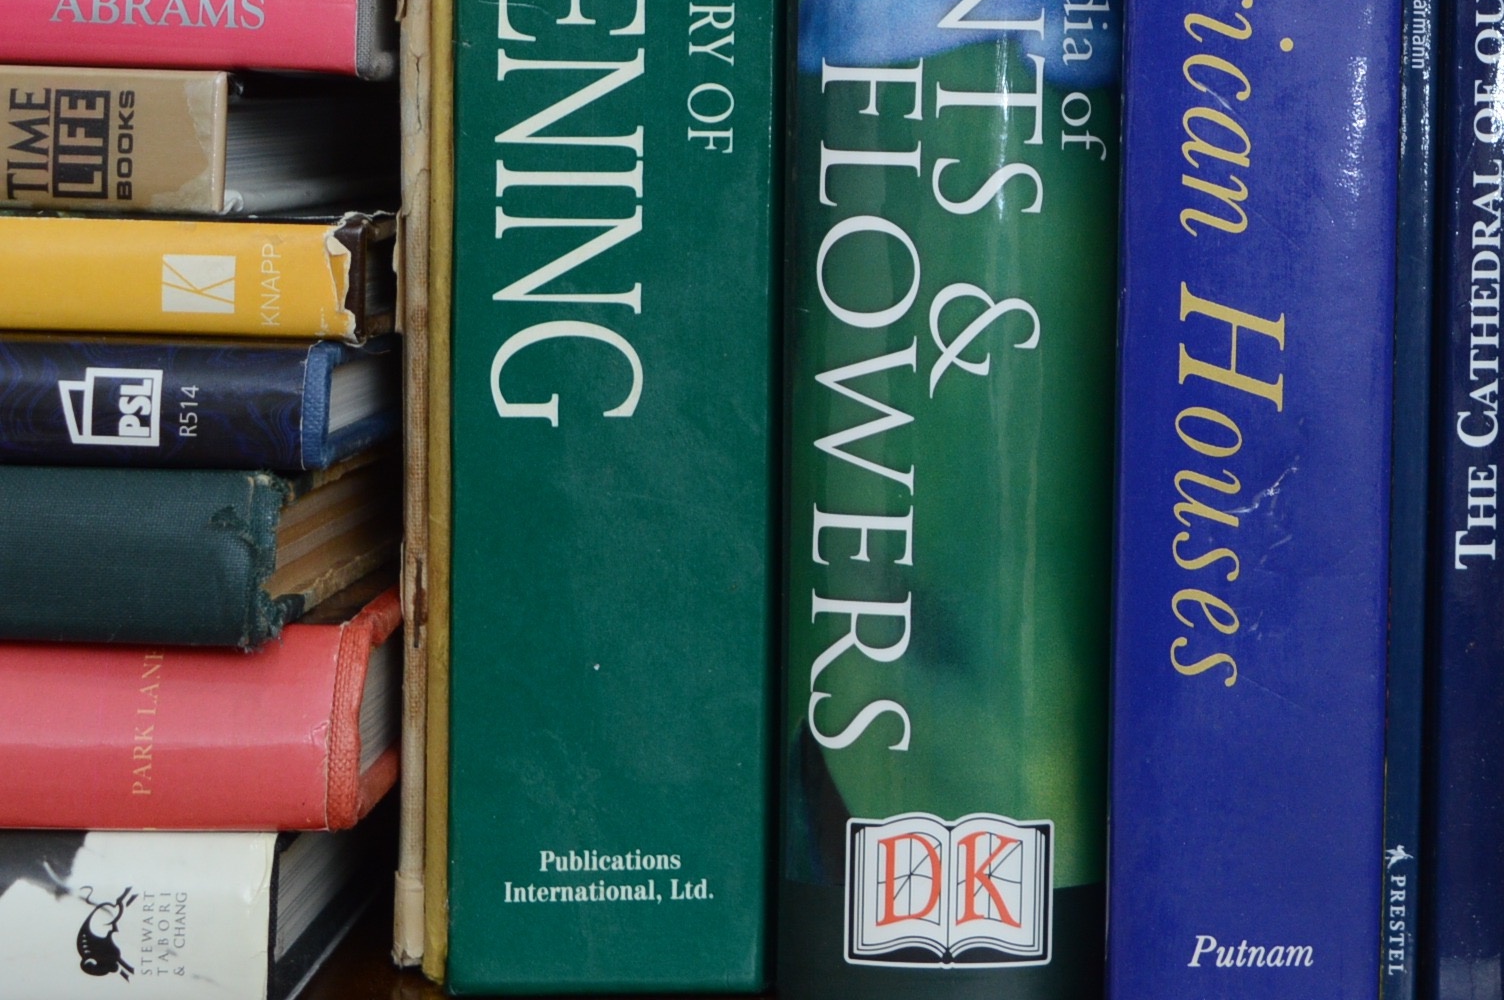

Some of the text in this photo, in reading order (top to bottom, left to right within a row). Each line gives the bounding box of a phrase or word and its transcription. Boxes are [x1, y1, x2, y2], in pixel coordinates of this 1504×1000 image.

[7, 87, 52, 201] TIME
[54, 90, 109, 199] LIFE
[116, 89, 136, 201] BOOKS
[686, 90, 735, 154] OF
[1059, 91, 1107, 162] of
[1472, 79, 1502, 145] OF
[260, 243, 282, 327] KNAPP
[1456, 158, 1502, 449] CATHEDRAL
[928, 281, 1041, 399] &
[118, 378, 154, 438] PSL
[179, 384, 200, 438] R514
[807, 56, 924, 752] FLOWERS
[1169, 280, 1286, 688] Houses
[1453, 463, 1498, 571] THE
[131, 724, 154, 796] PARK
[503, 878, 715, 904] International, Ltd.
[538, 848, 682, 872] Publications
[874, 830, 1023, 930] DK
[141, 891, 155, 976] STEWART
[157, 892, 171, 977] TABORI
[173, 892, 188, 977] & CHANG
[1186, 934, 1314, 969] Putnam
[1387, 874, 1407, 977] PRESTEL
